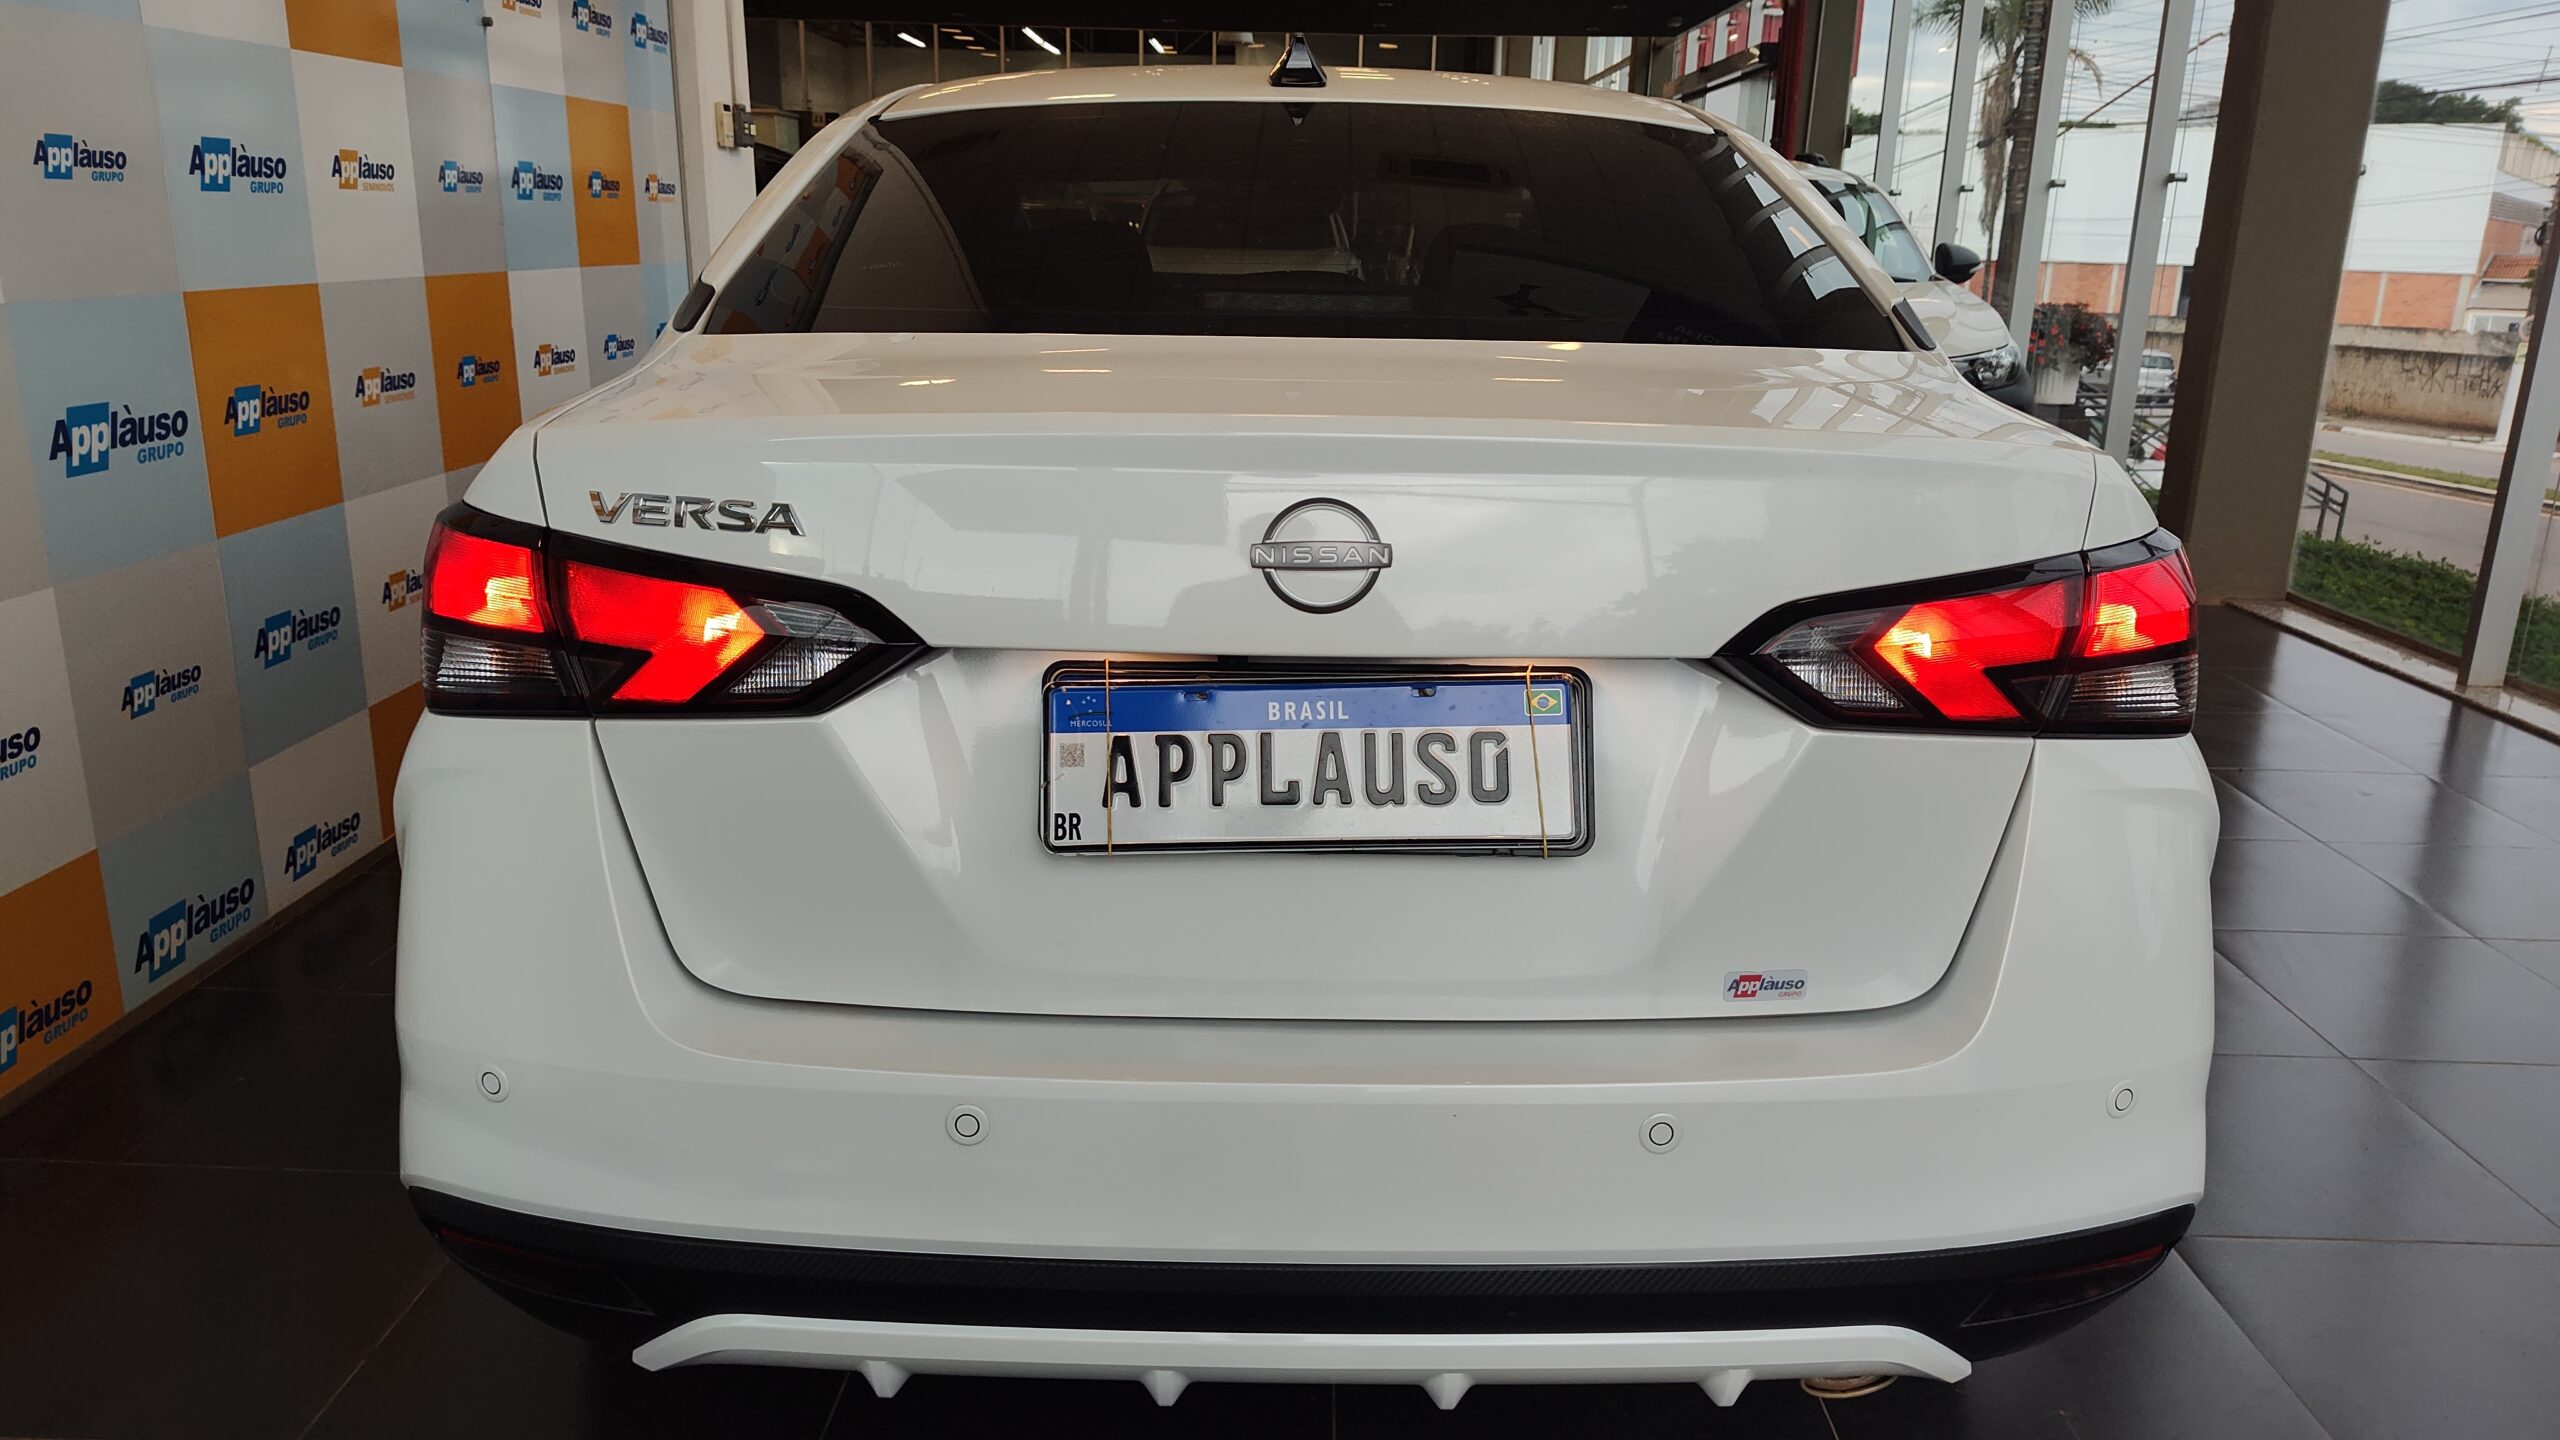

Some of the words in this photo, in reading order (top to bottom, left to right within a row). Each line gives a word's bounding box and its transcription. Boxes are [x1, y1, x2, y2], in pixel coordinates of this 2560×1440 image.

[33, 140, 127, 173] Applàuso
[189, 144, 286, 184] Applàuso
[332, 154, 394, 184] Applàuso
[92, 171, 124, 182] GRUPO
[250, 181, 283, 194] GRUPO
[438, 164, 483, 187] Applàuso
[511, 165, 563, 194] Applàuso
[356, 369, 415, 402] Applàuso
[224, 387, 310, 429] Applàuso
[277, 414, 307, 429] GRUPO
[49, 405, 188, 467] Applàuso
[137, 441, 184, 464] GRUPO
[589, 490, 806, 537] VERSA
[1255, 547, 1389, 564] NISSAN
[255, 606, 340, 660] Applàuso
[308, 629, 338, 650] GRUPO
[121, 665, 201, 712] Applàuso
[170, 684, 199, 703] GRUPO
[1267, 701, 1349, 721] BRASIL
[1101, 731, 1509, 807] APPLAUSO
[1054, 813, 1081, 840] BR
[284, 812, 360, 874] Applàuso
[331, 834, 358, 856] GRUPO
[134, 878, 255, 974] Applàuso
[210, 907, 251, 943] GRUPO
[1727, 976, 1805, 995] Applàuso
[44, 1008, 88, 1045] GRUPO
